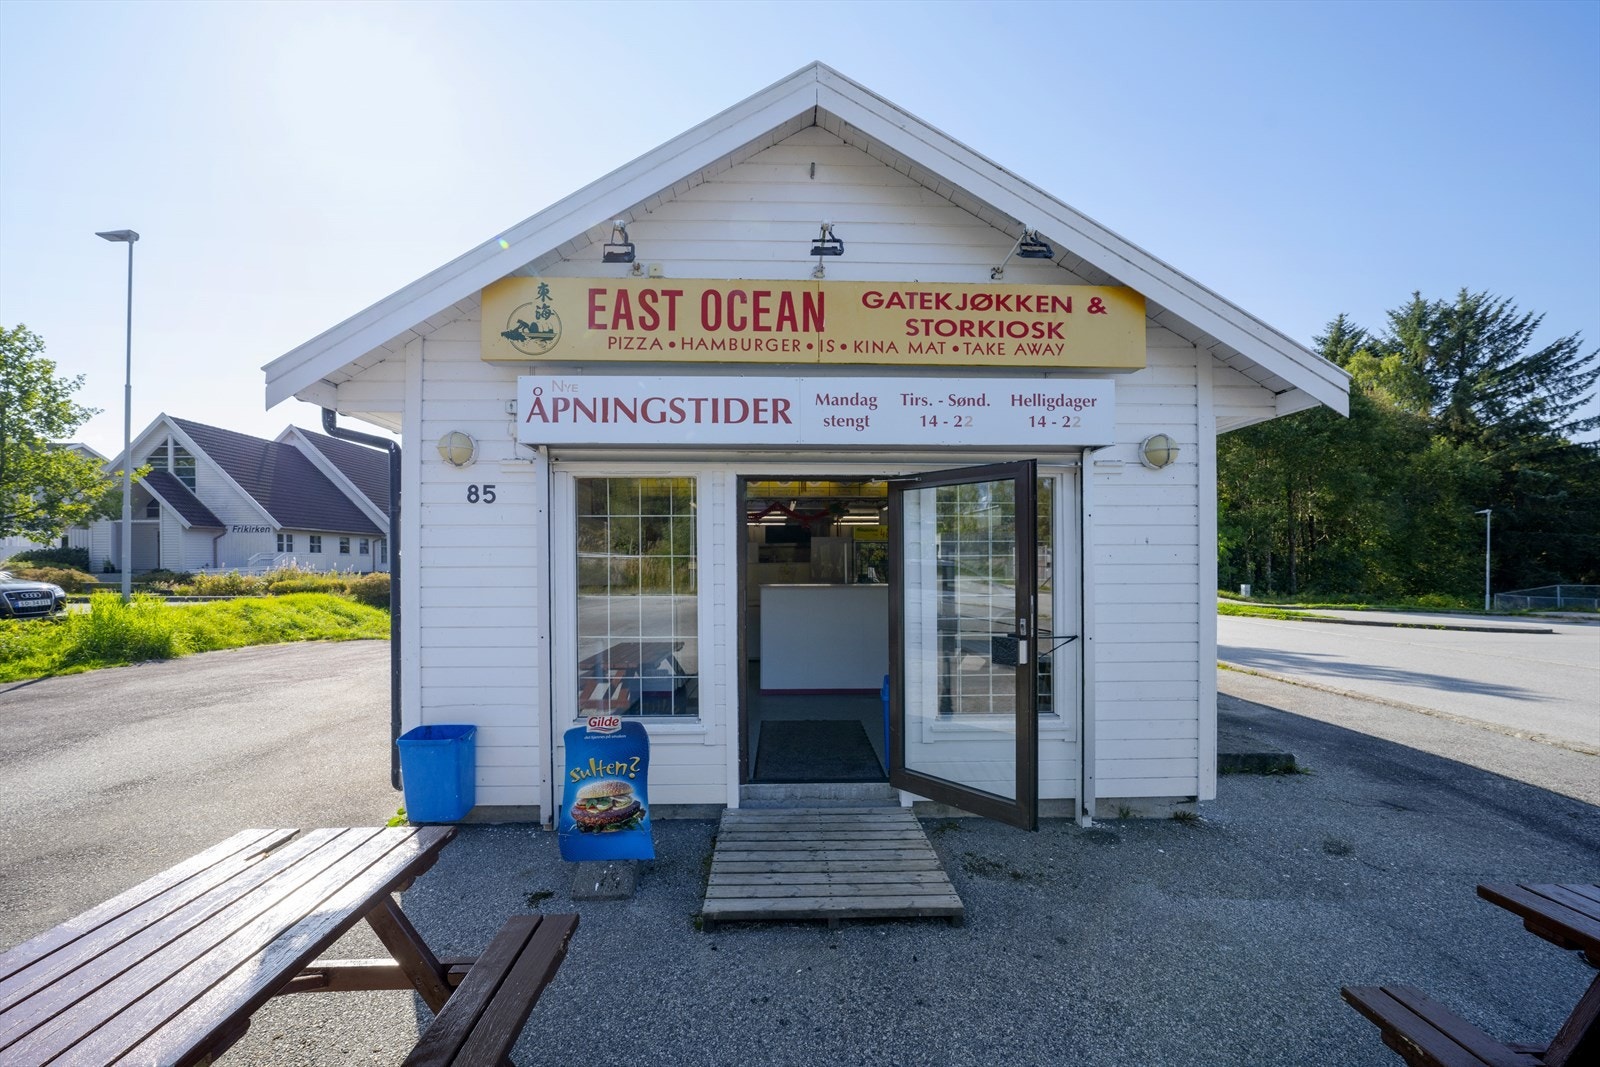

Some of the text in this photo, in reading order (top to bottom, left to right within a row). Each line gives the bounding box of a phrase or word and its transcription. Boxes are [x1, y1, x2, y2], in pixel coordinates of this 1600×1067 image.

[587, 287, 825, 334] EAST OCEAN
[861, 290, 1107, 315] GATEKJØKKEN &
[905, 317, 1066, 340] STORKIOSK
[607, 336, 1066, 357] PIZZA HAMBURGER IS KINA MAT TAKE AWAY
[526, 386, 793, 425] ÅPNINGSTIDER
[815, 392, 878, 411] Mandag
[900, 393, 933, 407] Tirs.
[948, 392, 991, 408] Sønd.
[1011, 393, 1098, 412] Helligdager
[823, 414, 870, 432] stengt
[920, 415, 938, 428] 14
[953, 415, 974, 428] 22
[1029, 415, 1048, 428] 14
[1061, 416, 1082, 429] 22
[466, 484, 497, 504] 85
[232, 525, 271, 533] Frikirken
[588, 716, 619, 727] Gilde
